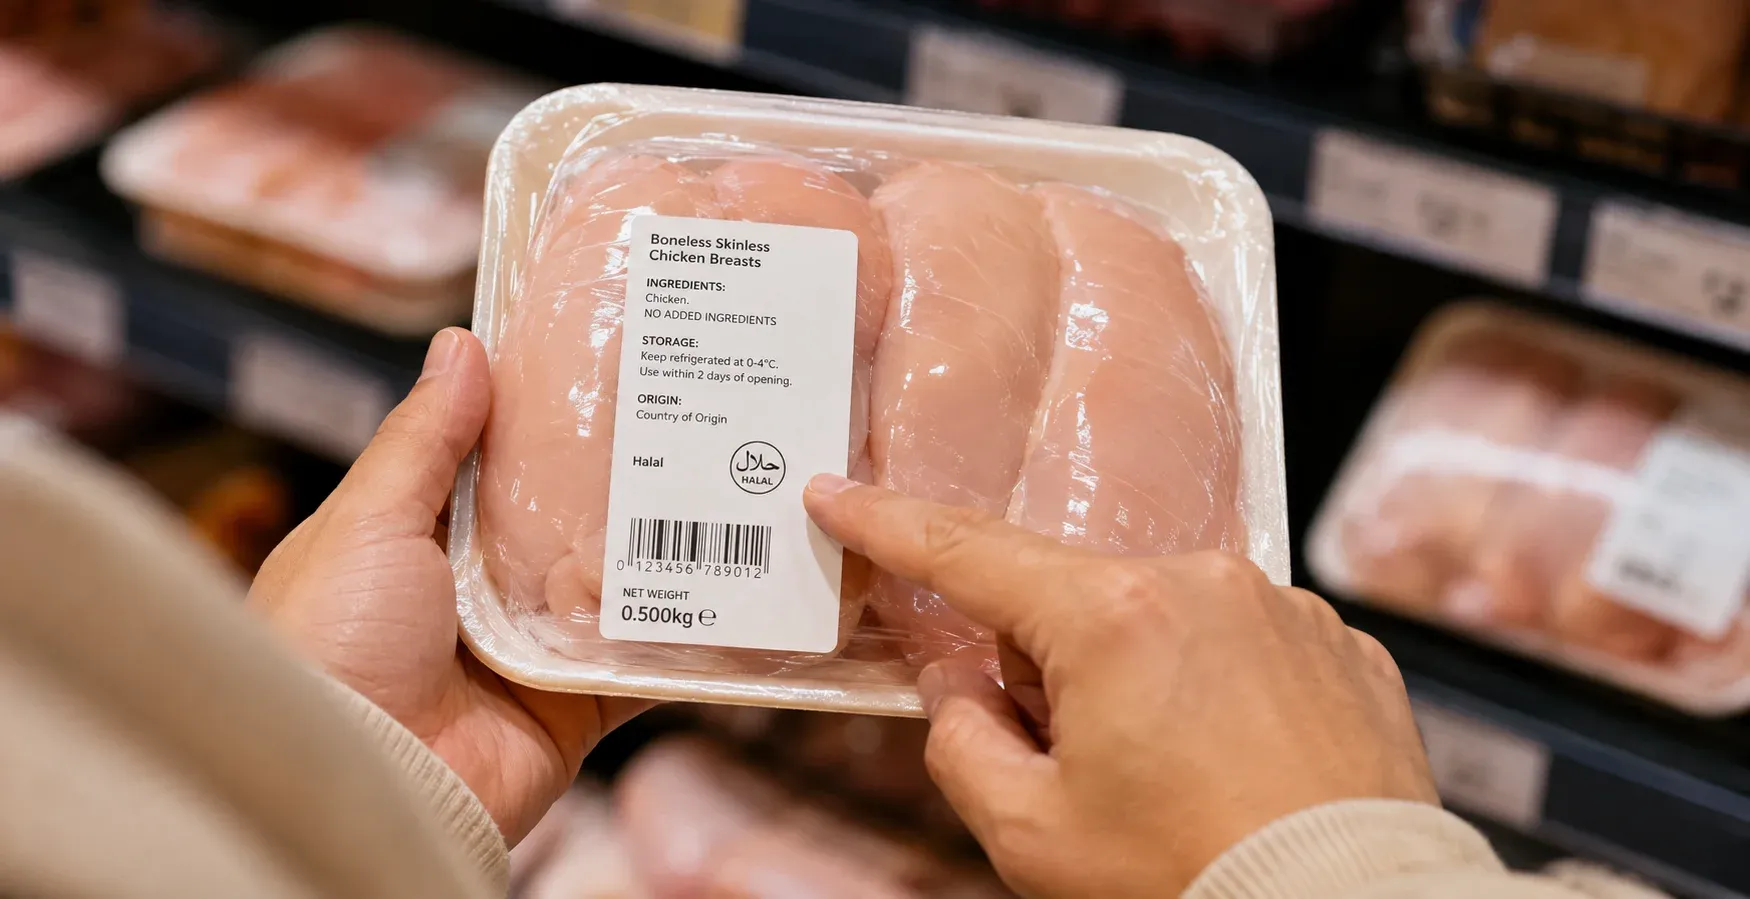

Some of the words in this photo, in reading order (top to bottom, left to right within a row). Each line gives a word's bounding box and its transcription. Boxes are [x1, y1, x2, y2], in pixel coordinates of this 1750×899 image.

[651, 234, 711, 248] Boneless
[716, 238, 770, 252] Skinless
[650, 250, 705, 263] Chicken
[710, 253, 761, 267] Breasts
[646, 278, 726, 292] INGREDIENTS:
[646, 293, 689, 304] Chicken.
[645, 309, 661, 318] NO
[664, 310, 702, 320] ADDED
[705, 313, 776, 325] INGREDIENTS
[642, 336, 698, 347] STORAGE:
[641, 351, 666, 363] Keep
[670, 353, 730, 365] refrigerated
[747, 358, 778, 368] 0-4°C.
[640, 367, 659, 376] Use
[663, 369, 694, 378] within
[698, 370, 704, 379] 2
[707, 371, 730, 383] days
[734, 373, 744, 381] of
[747, 375, 792, 387] opening.
[638, 394, 681, 405] ORIGIN:
[636, 410, 678, 423] Country
[682, 412, 692, 421] of
[695, 413, 727, 425] Origin
[633, 456, 663, 467] Halal
[736, 451, 780, 472] حلال
[742, 476, 773, 485] HALAL
[616, 560, 625, 571] 0
[636, 561, 693, 574] 123456
[704, 564, 762, 579] 789012
[623, 588, 644, 597] NET
[647, 589, 690, 600] WEIGHT
[622, 605, 693, 628] 0.500kg
